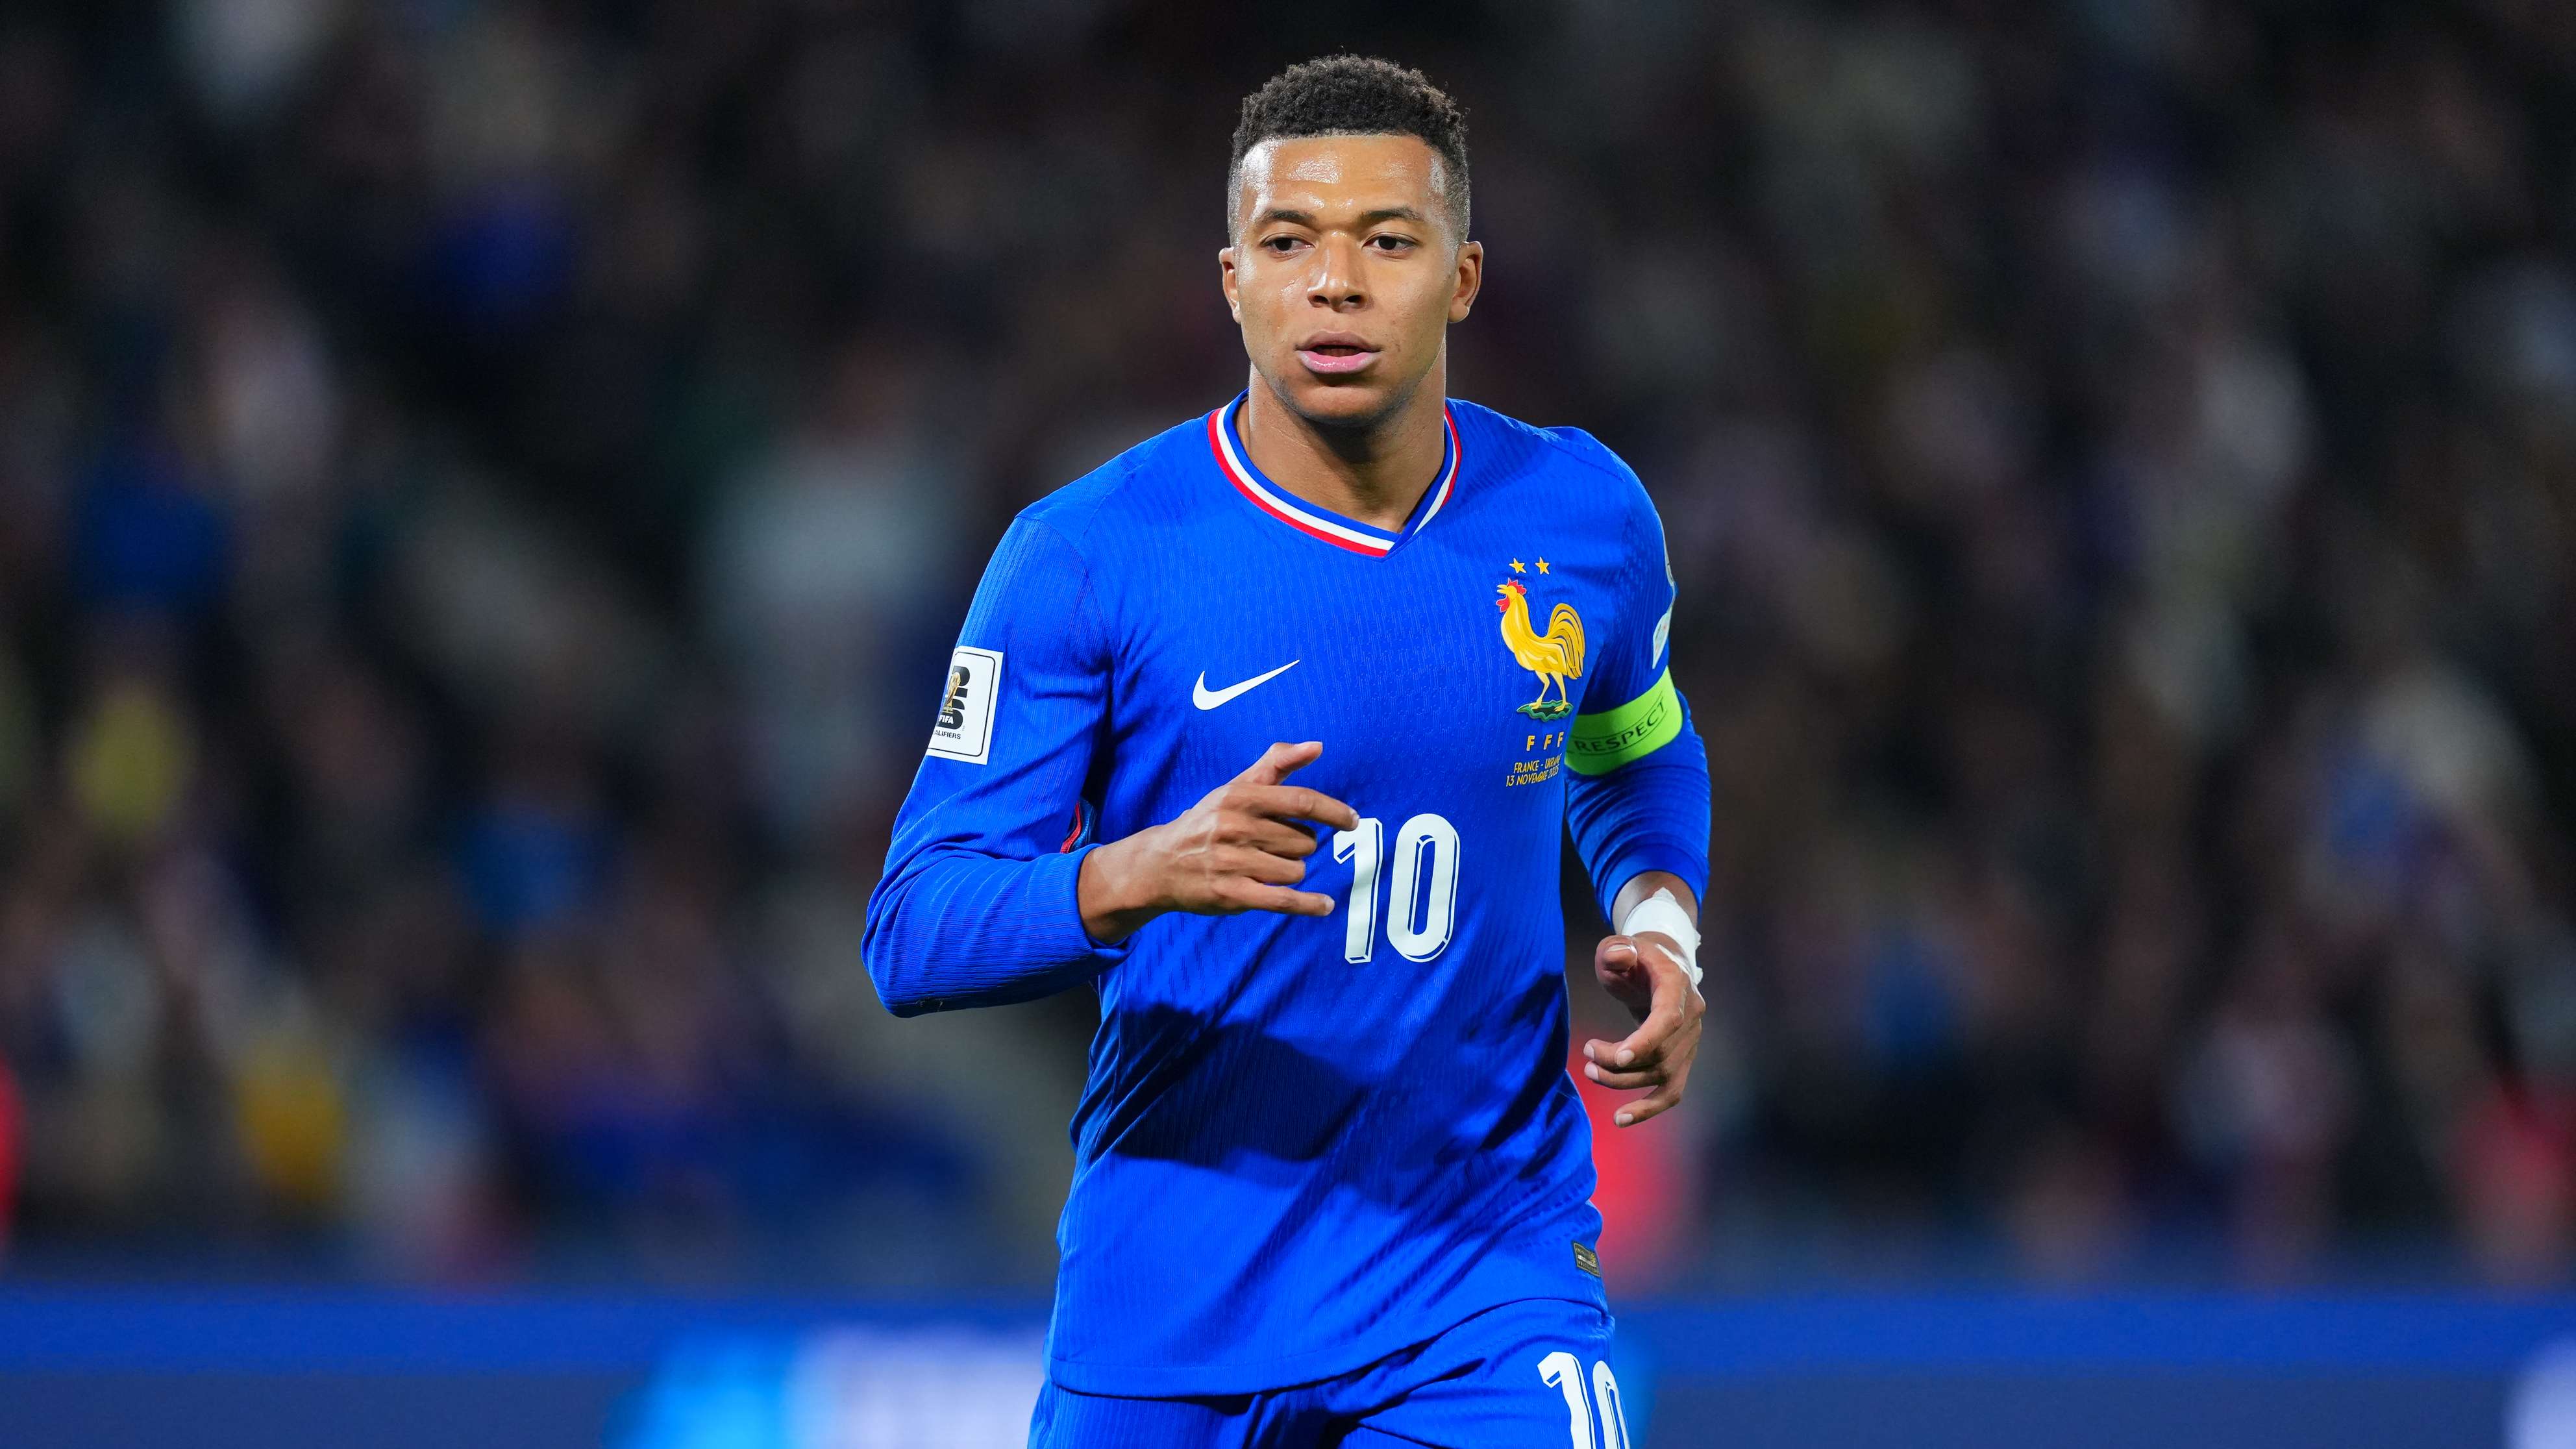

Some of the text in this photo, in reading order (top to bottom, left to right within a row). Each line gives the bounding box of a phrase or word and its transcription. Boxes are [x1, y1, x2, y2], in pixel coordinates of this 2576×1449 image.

[938, 714, 954, 724] FIFA
[1573, 697, 1664, 752] RESPECT
[1506, 774, 1515, 787] 13
[1513, 760, 1540, 774] FRANCE
[1333, 813, 1460, 964] 10
[1537, 1352, 1631, 1449] 10
